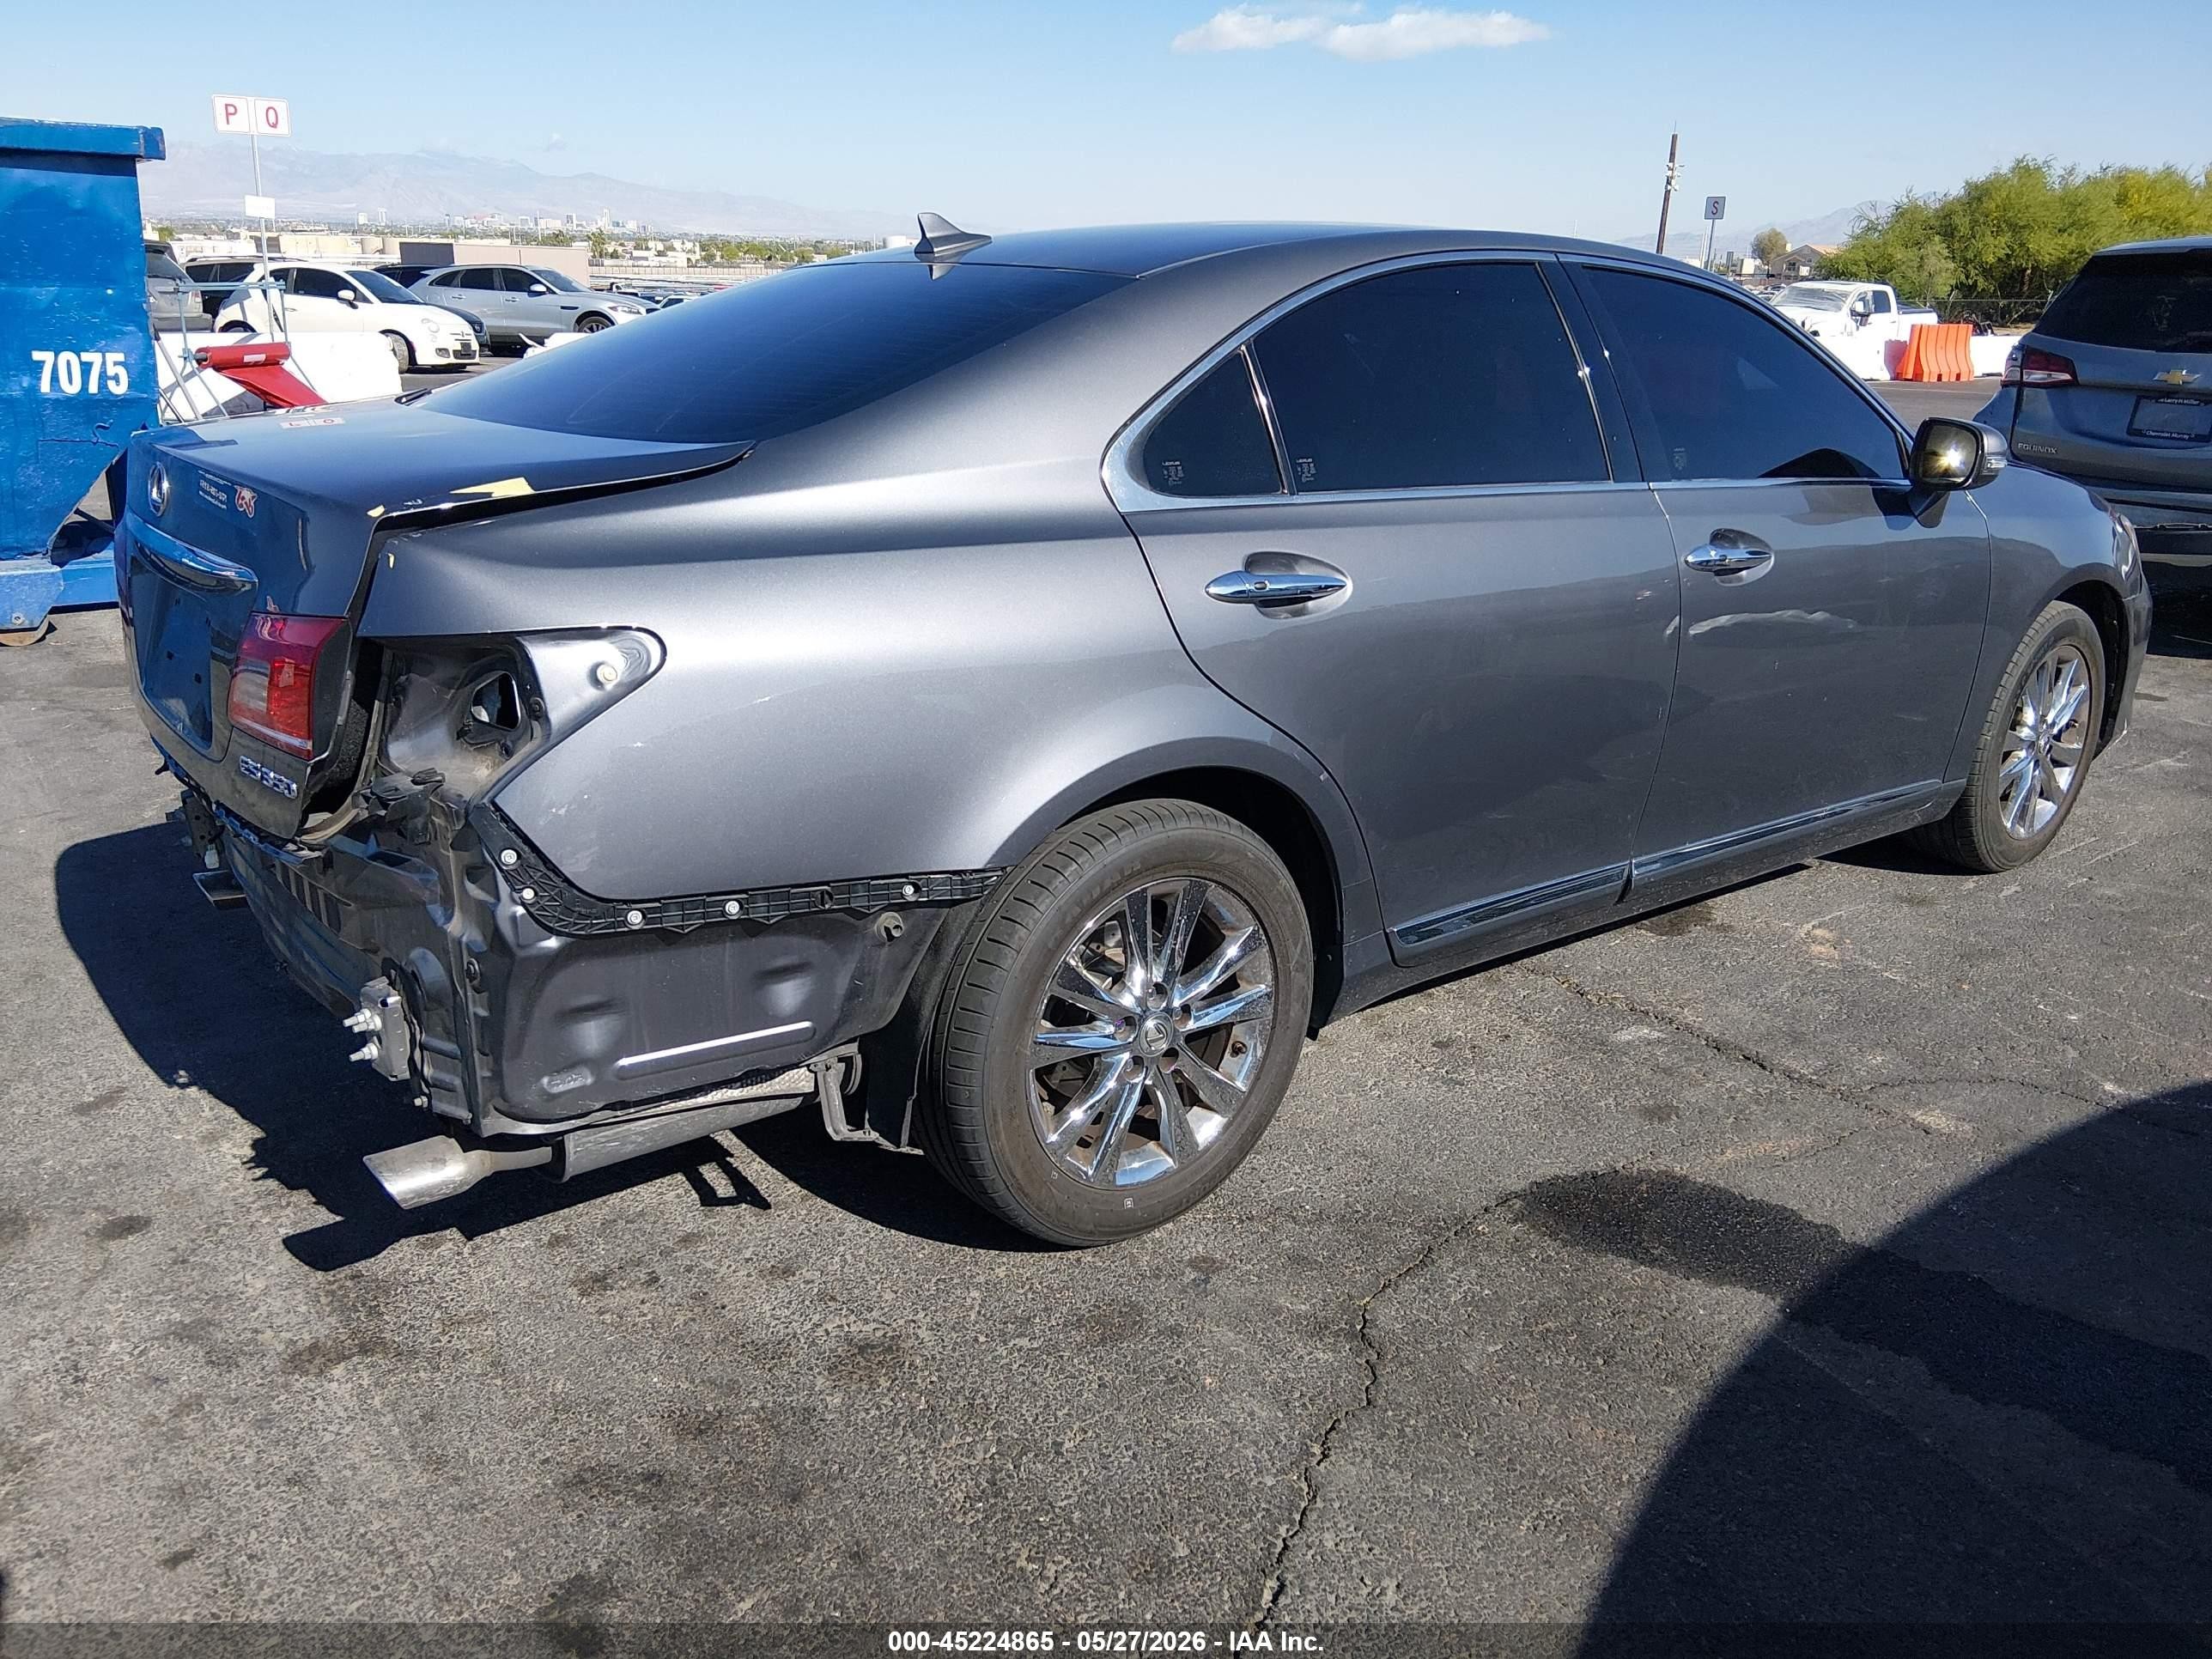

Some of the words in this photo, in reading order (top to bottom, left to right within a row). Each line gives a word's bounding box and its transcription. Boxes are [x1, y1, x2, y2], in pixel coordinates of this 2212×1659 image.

[224, 102, 238, 126] P
[265, 106, 280, 130] Q
[1711, 200, 1720, 216] S
[32, 350, 130, 395] 7075
[2018, 442, 2057, 454] EQUINOX
